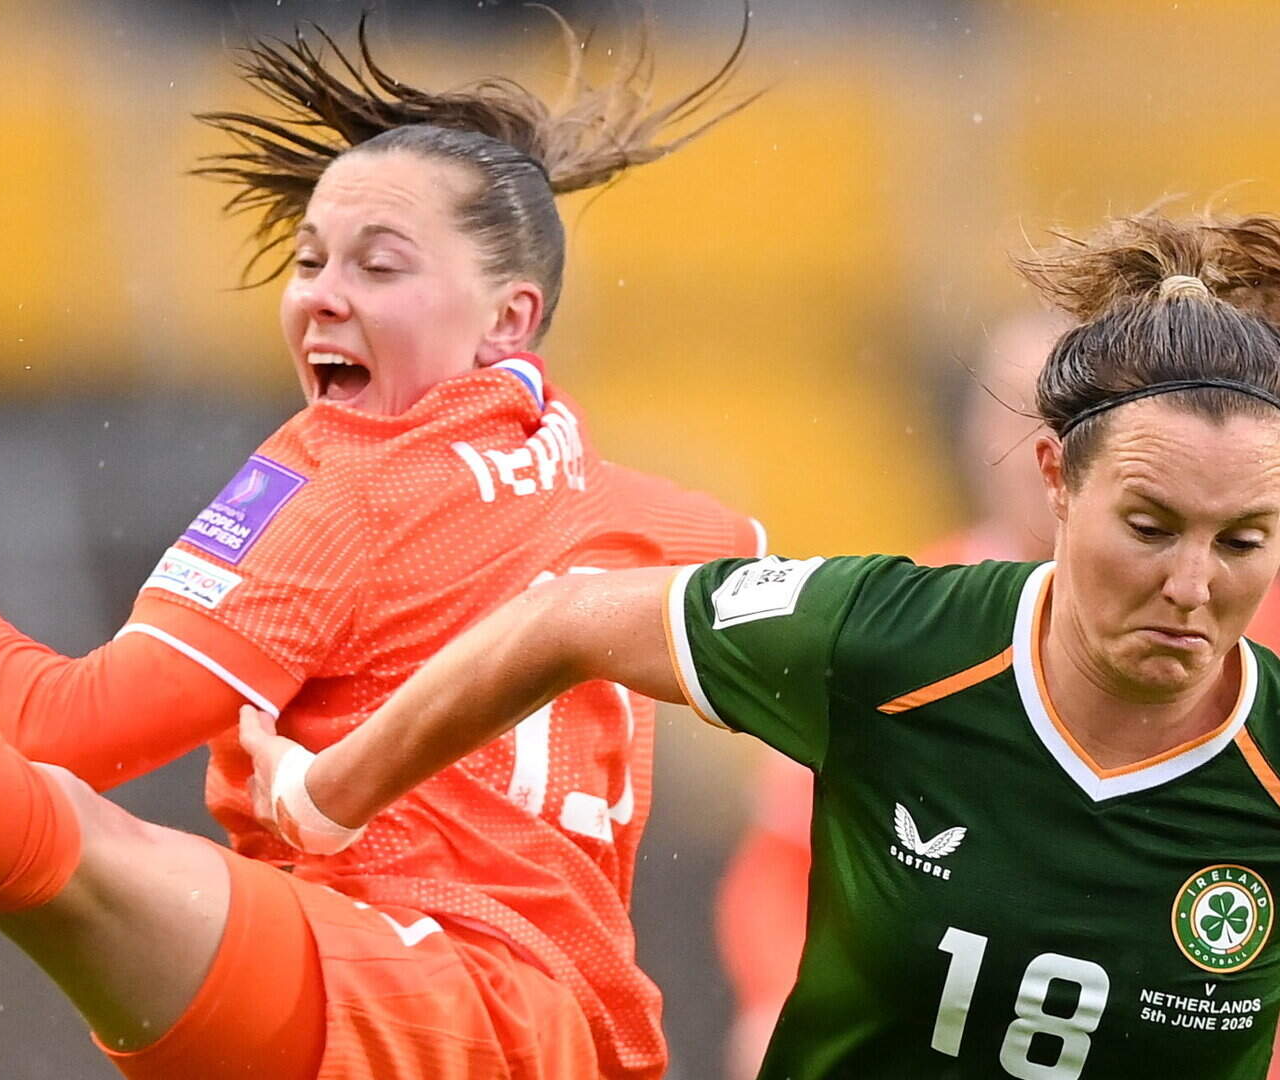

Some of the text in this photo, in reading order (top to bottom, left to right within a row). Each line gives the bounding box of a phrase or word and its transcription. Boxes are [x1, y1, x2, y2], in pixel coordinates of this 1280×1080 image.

[890, 845, 952, 881] CASTORE
[1187, 869, 1268, 908] IRELAND
[1187, 942, 1247, 966] FOOTBALL
[1140, 989, 1262, 1014] NETHERLANDS
[1205, 983, 1217, 997] V
[1140, 1007, 1254, 1031] 5th JUNE 2026
